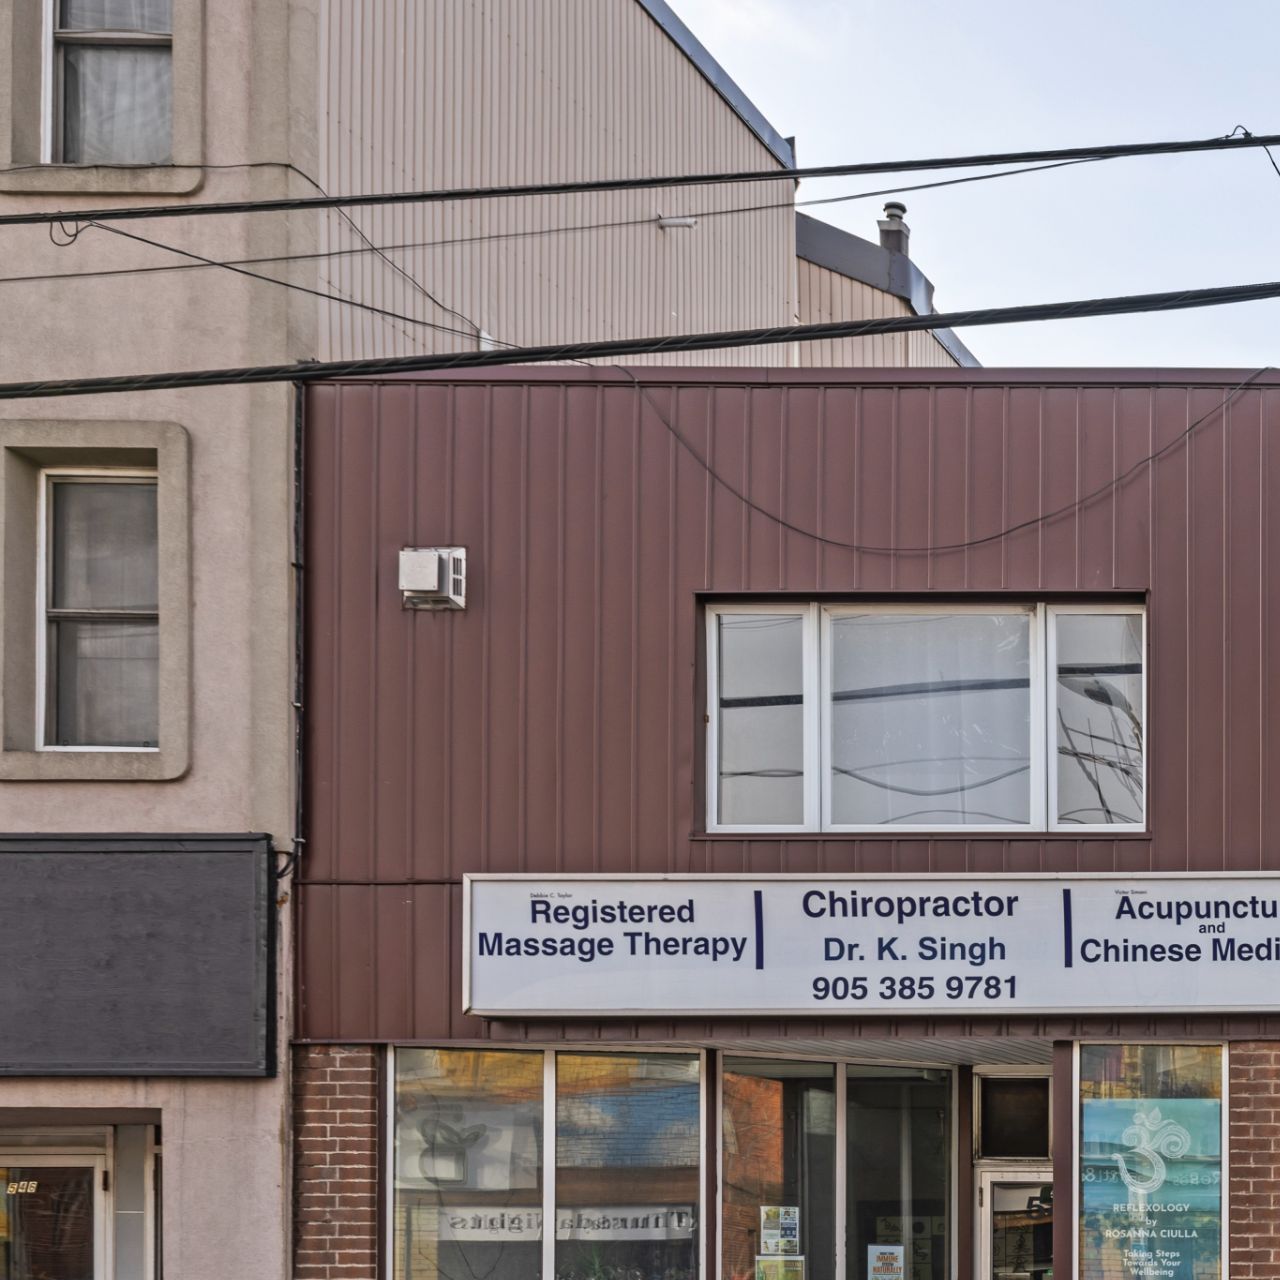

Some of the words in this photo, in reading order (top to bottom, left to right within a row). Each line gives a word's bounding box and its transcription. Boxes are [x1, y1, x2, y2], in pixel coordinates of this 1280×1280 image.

[802, 890, 1019, 924] Chiropractor
[530, 899, 695, 930] Registered
[1198, 922, 1226, 934] and
[478, 932, 614, 962] Massage
[623, 932, 747, 962] Therapy
[824, 937, 865, 961] Dr.
[877, 937, 907, 960] K.
[918, 936, 1006, 967] Singh
[1080, 938, 1202, 963] Chinese
[812, 976, 868, 1000] 905
[878, 976, 935, 1000] 385
[945, 975, 1016, 999] 9781
[7, 1182, 38, 1194] 546
[1113, 1203, 1190, 1212] REFLEXOLOGY
[1146, 1217, 1157, 1227] by
[1105, 1230, 1157, 1238] ROSANNA
[1160, 1229, 1198, 1238] CIULLA
[1124, 1250, 1153, 1259] Taking
[1156, 1250, 1181, 1259] Steps
[1123, 1259, 1158, 1267] Towards
[1160, 1259, 1181, 1267] Your
[1130, 1268, 1174, 1277] Wellbeing
